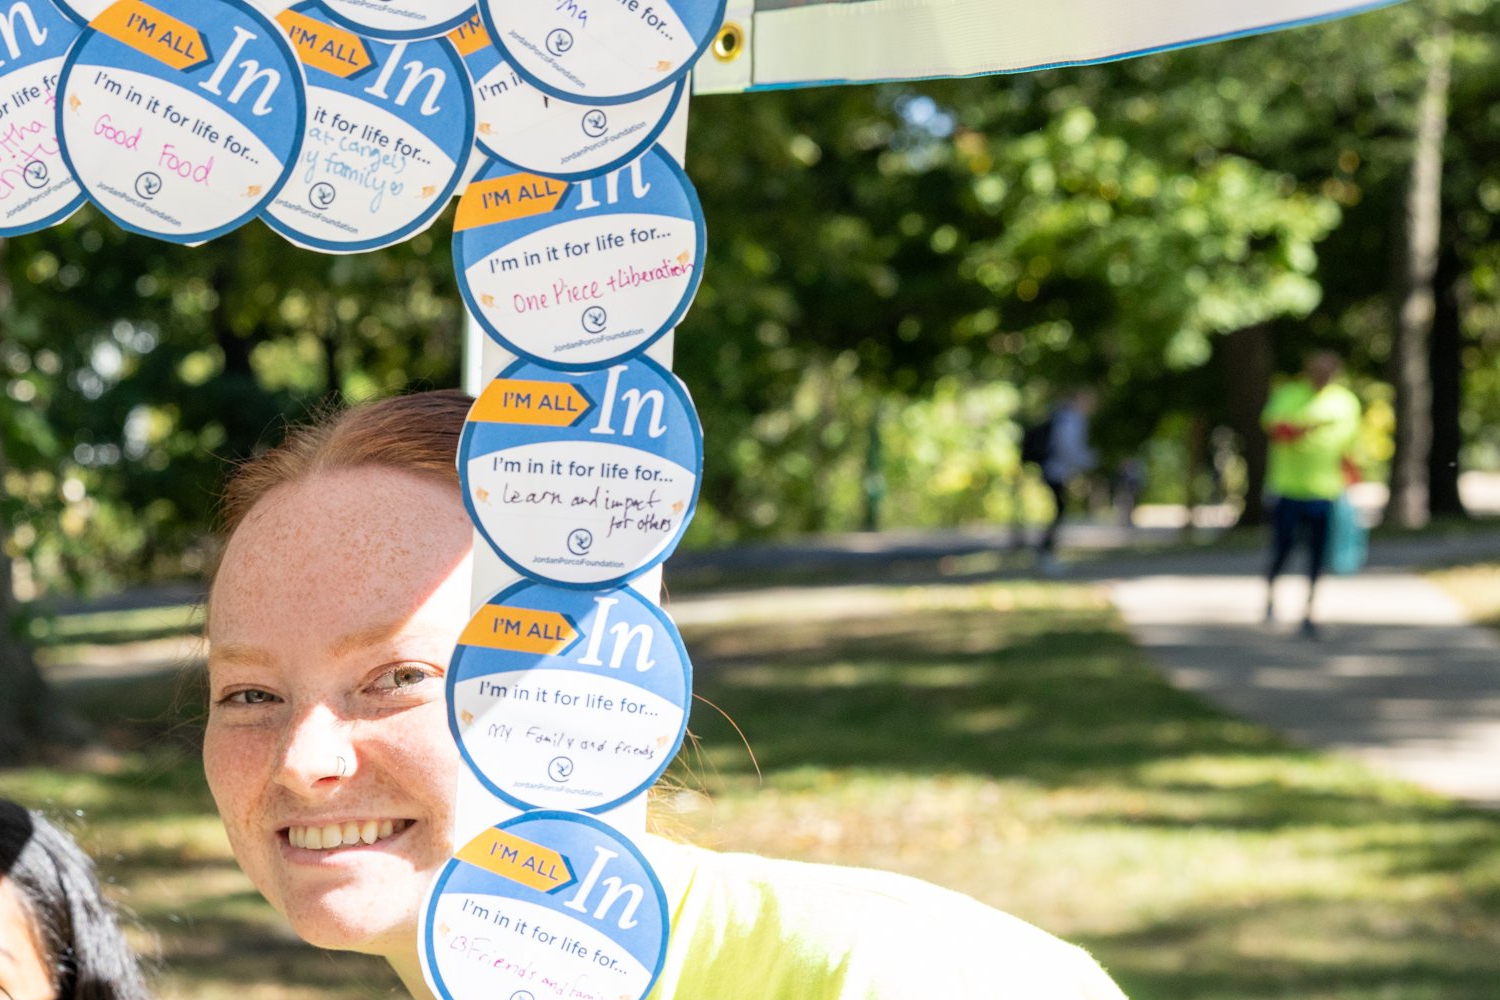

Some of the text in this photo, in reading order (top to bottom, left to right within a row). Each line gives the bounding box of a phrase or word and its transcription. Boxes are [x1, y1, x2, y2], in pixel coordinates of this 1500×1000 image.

[126, 12, 285, 118] I'M ALL In
[94, 114, 216, 187] Good Food
[481, 181, 558, 209] I'M ALL
[512, 292, 550, 314] One
[552, 278, 604, 306] Piece
[503, 364, 668, 438] I'M ALL In
[492, 457, 674, 483] I'm in it for life for...
[571, 485, 599, 510] and
[606, 515, 673, 538] for others
[580, 739, 608, 752] and
